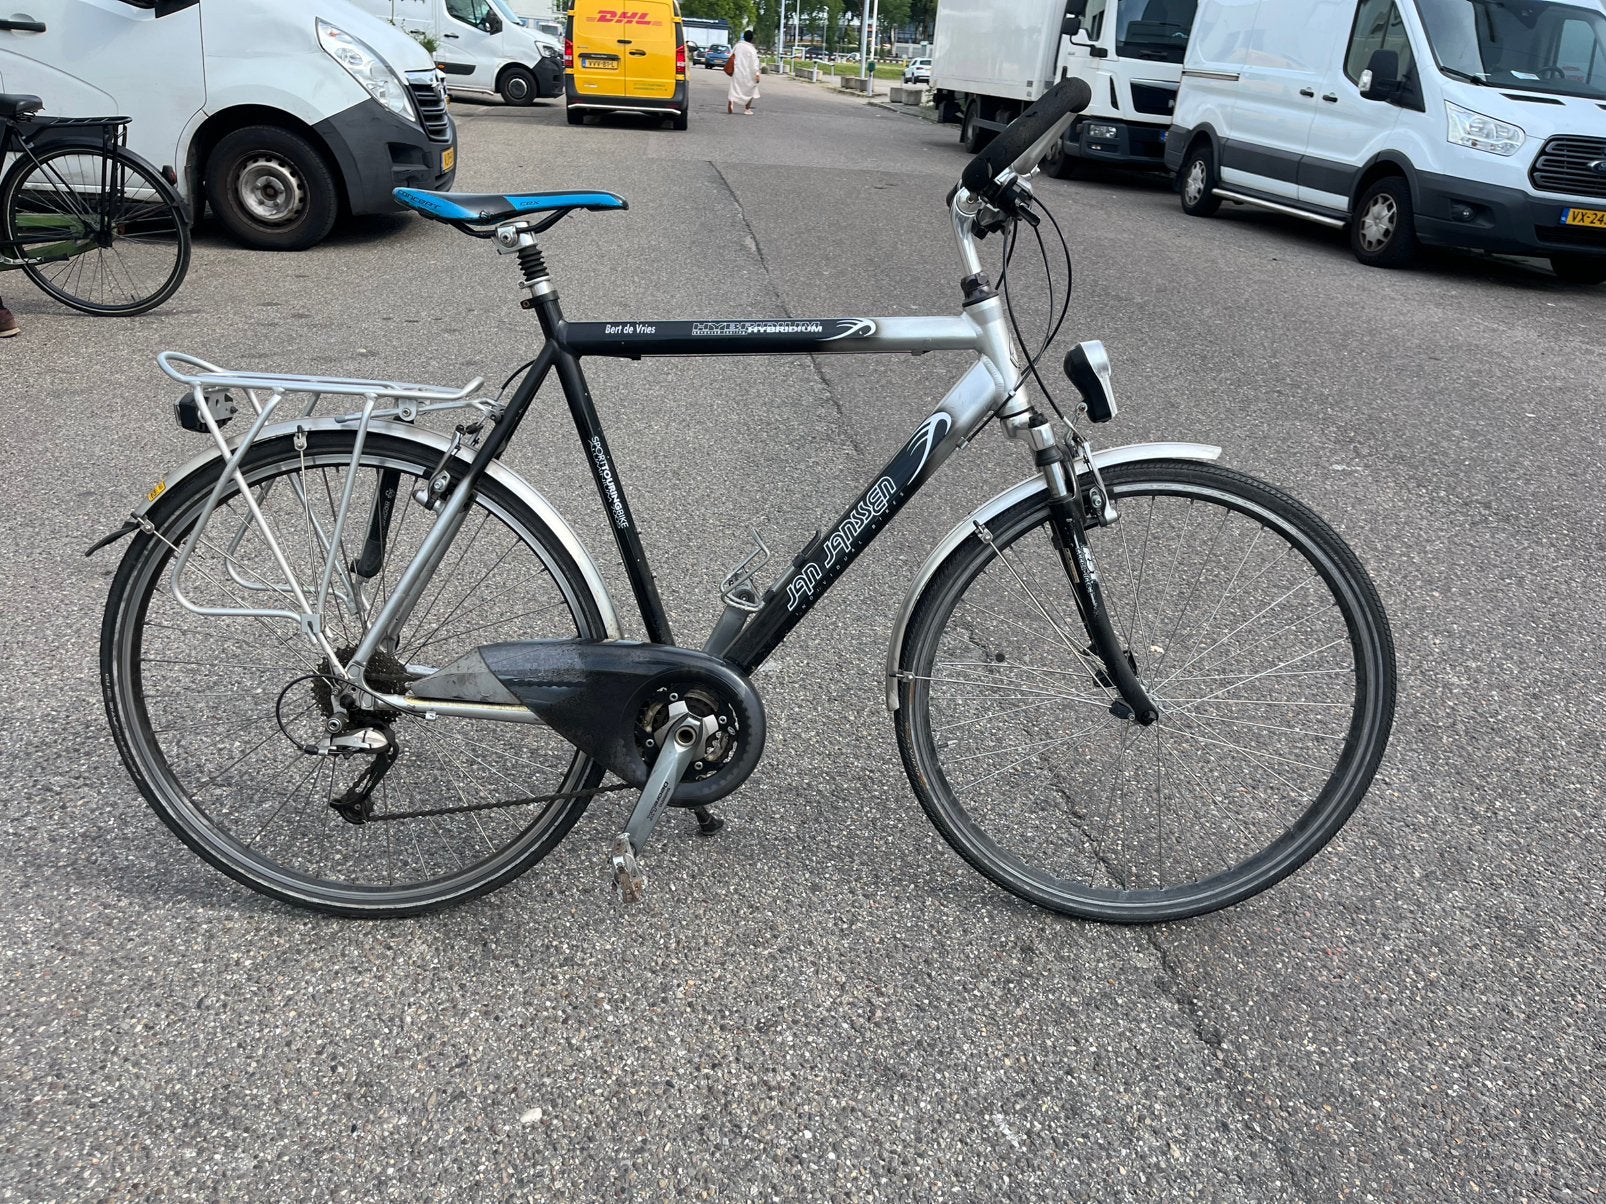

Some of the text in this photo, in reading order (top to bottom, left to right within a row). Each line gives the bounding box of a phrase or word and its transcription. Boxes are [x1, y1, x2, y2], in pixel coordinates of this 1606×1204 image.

[597, 10, 651, 26] DHL
[1572, 210, 1606, 225] VX-24
[605, 324, 656, 334] Bert de Vries
[747, 325, 823, 333] HYBRIDIUM
[794, 492, 905, 617] INDIVIDUAL BIKES
